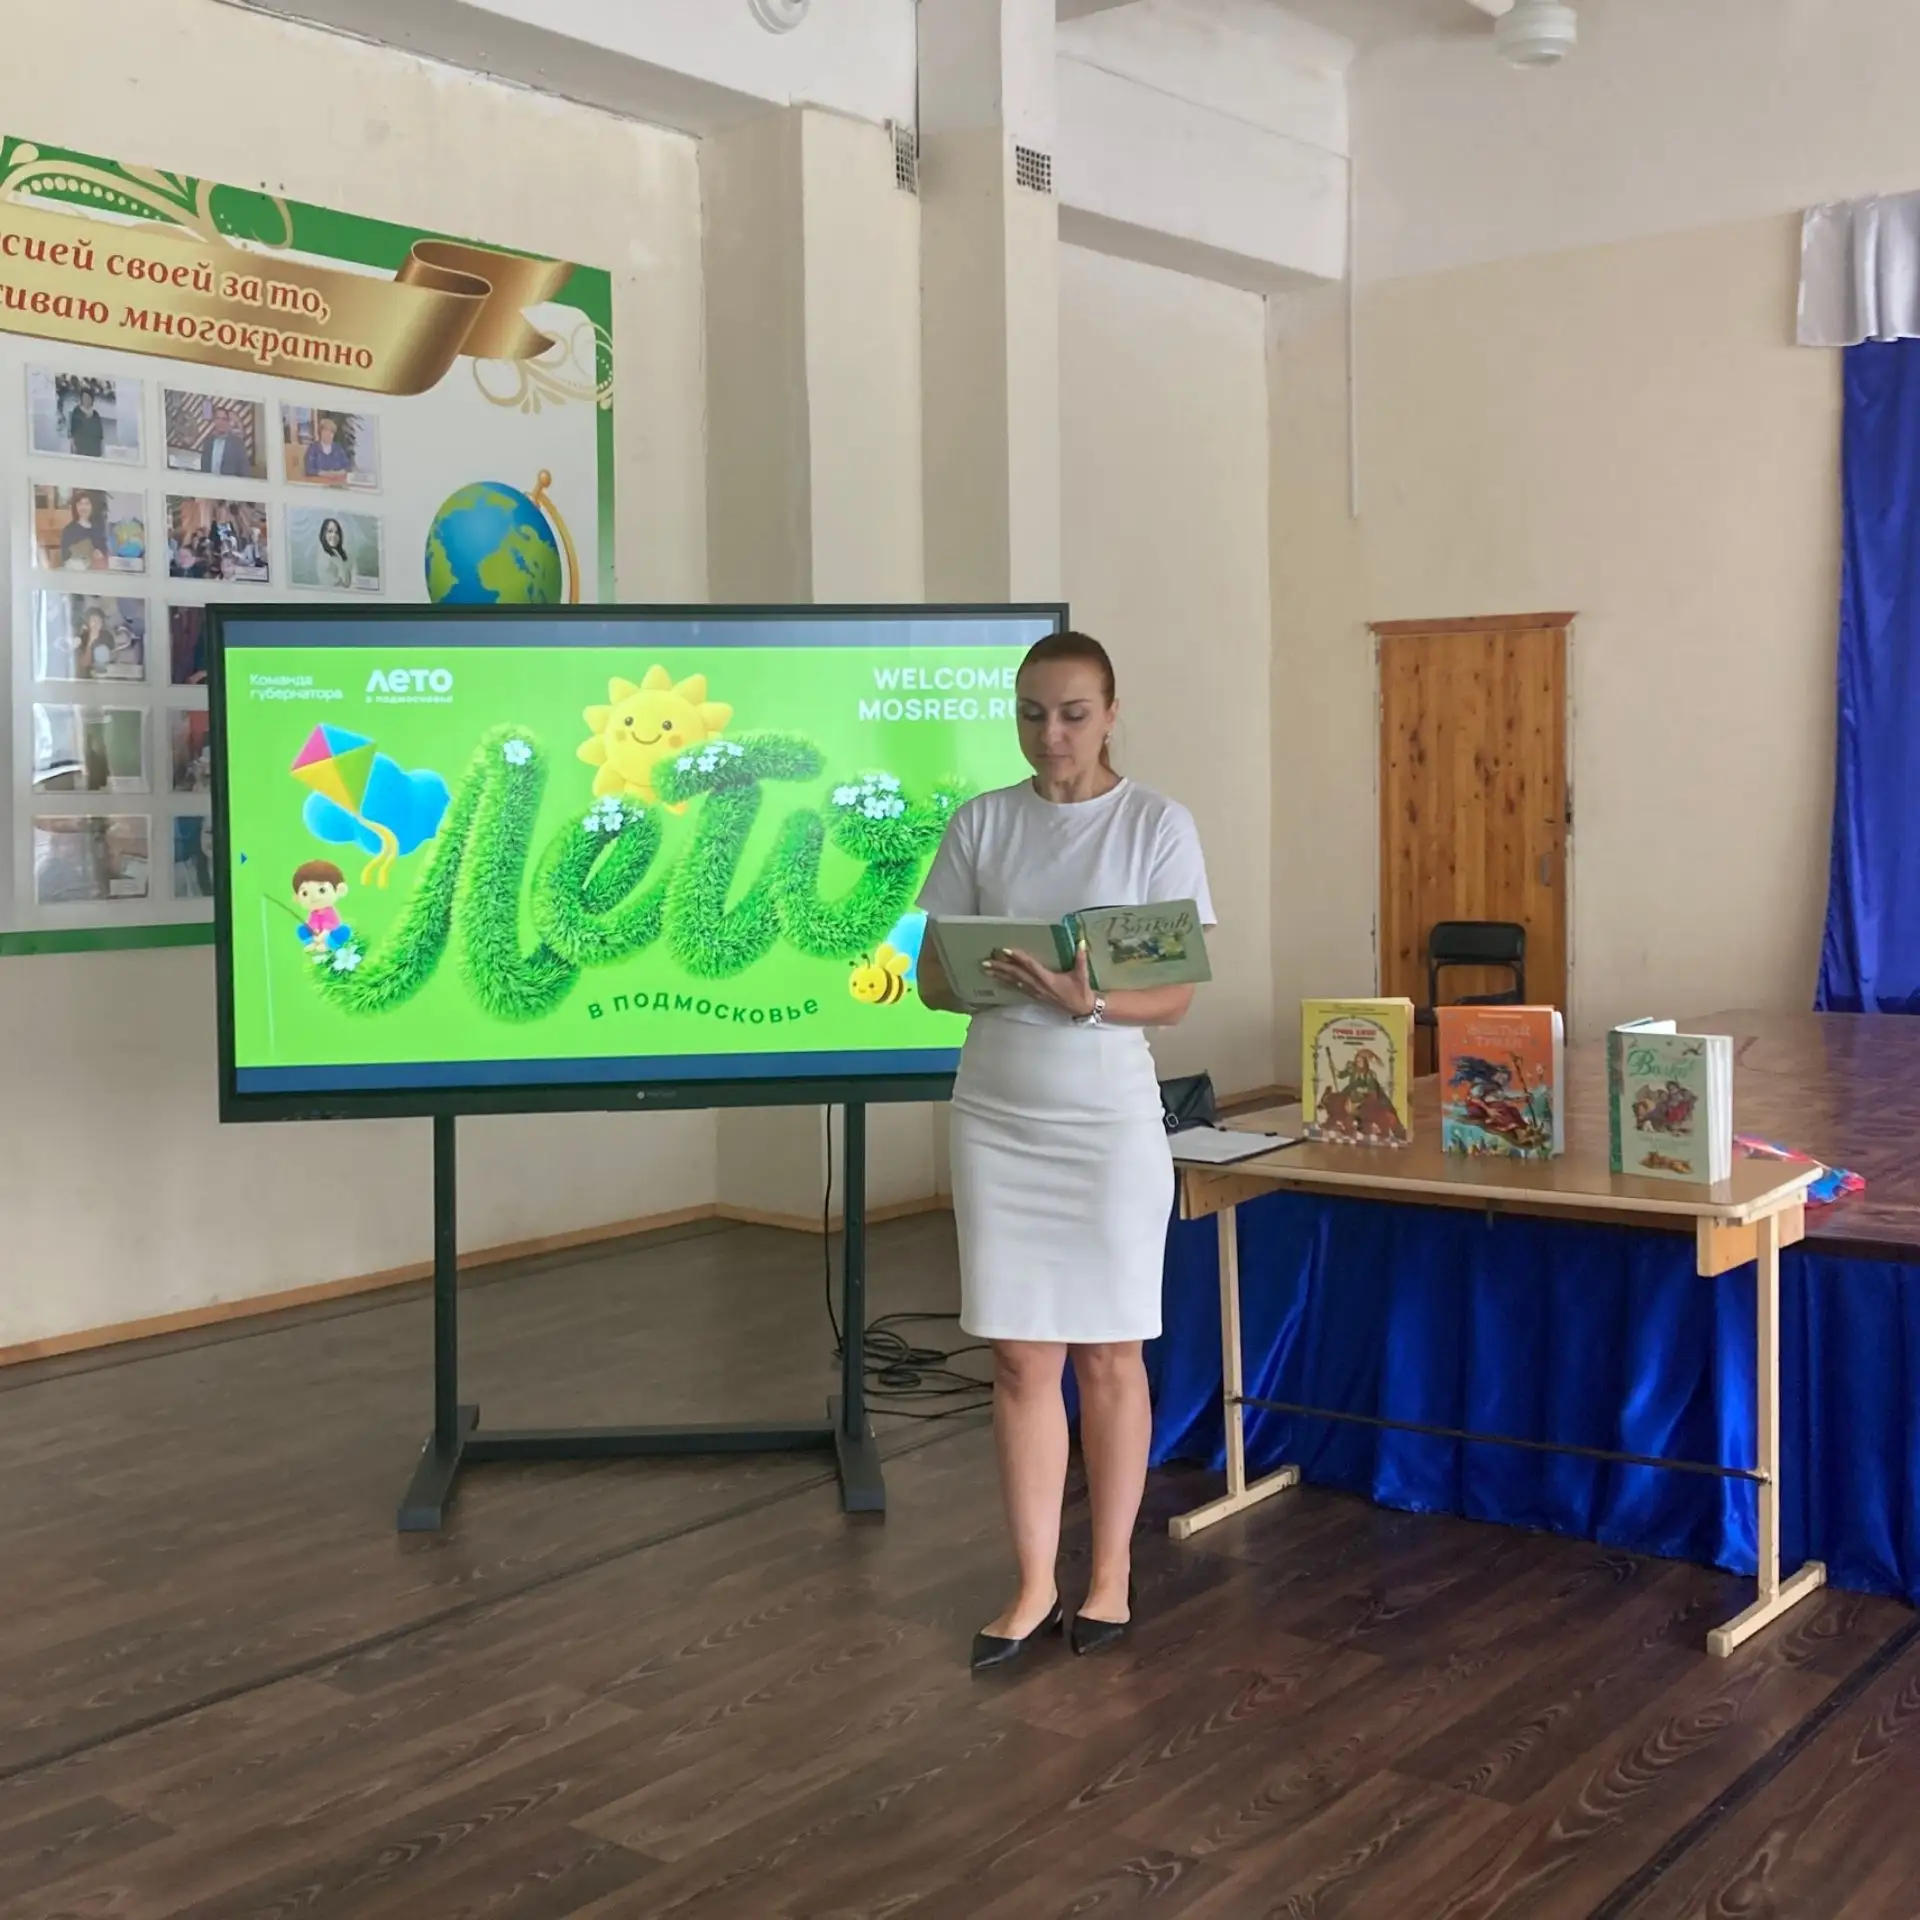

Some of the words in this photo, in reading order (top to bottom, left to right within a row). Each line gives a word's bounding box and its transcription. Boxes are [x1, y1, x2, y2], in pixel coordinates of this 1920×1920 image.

[0, 231, 94, 271] сией
[106, 254, 212, 293] своей
[223, 276, 260, 302] за
[271, 284, 328, 320] то,
[0, 284, 109, 324] иваю
[119, 306, 374, 369] многократно
[873, 667, 1017, 690] WELCOME
